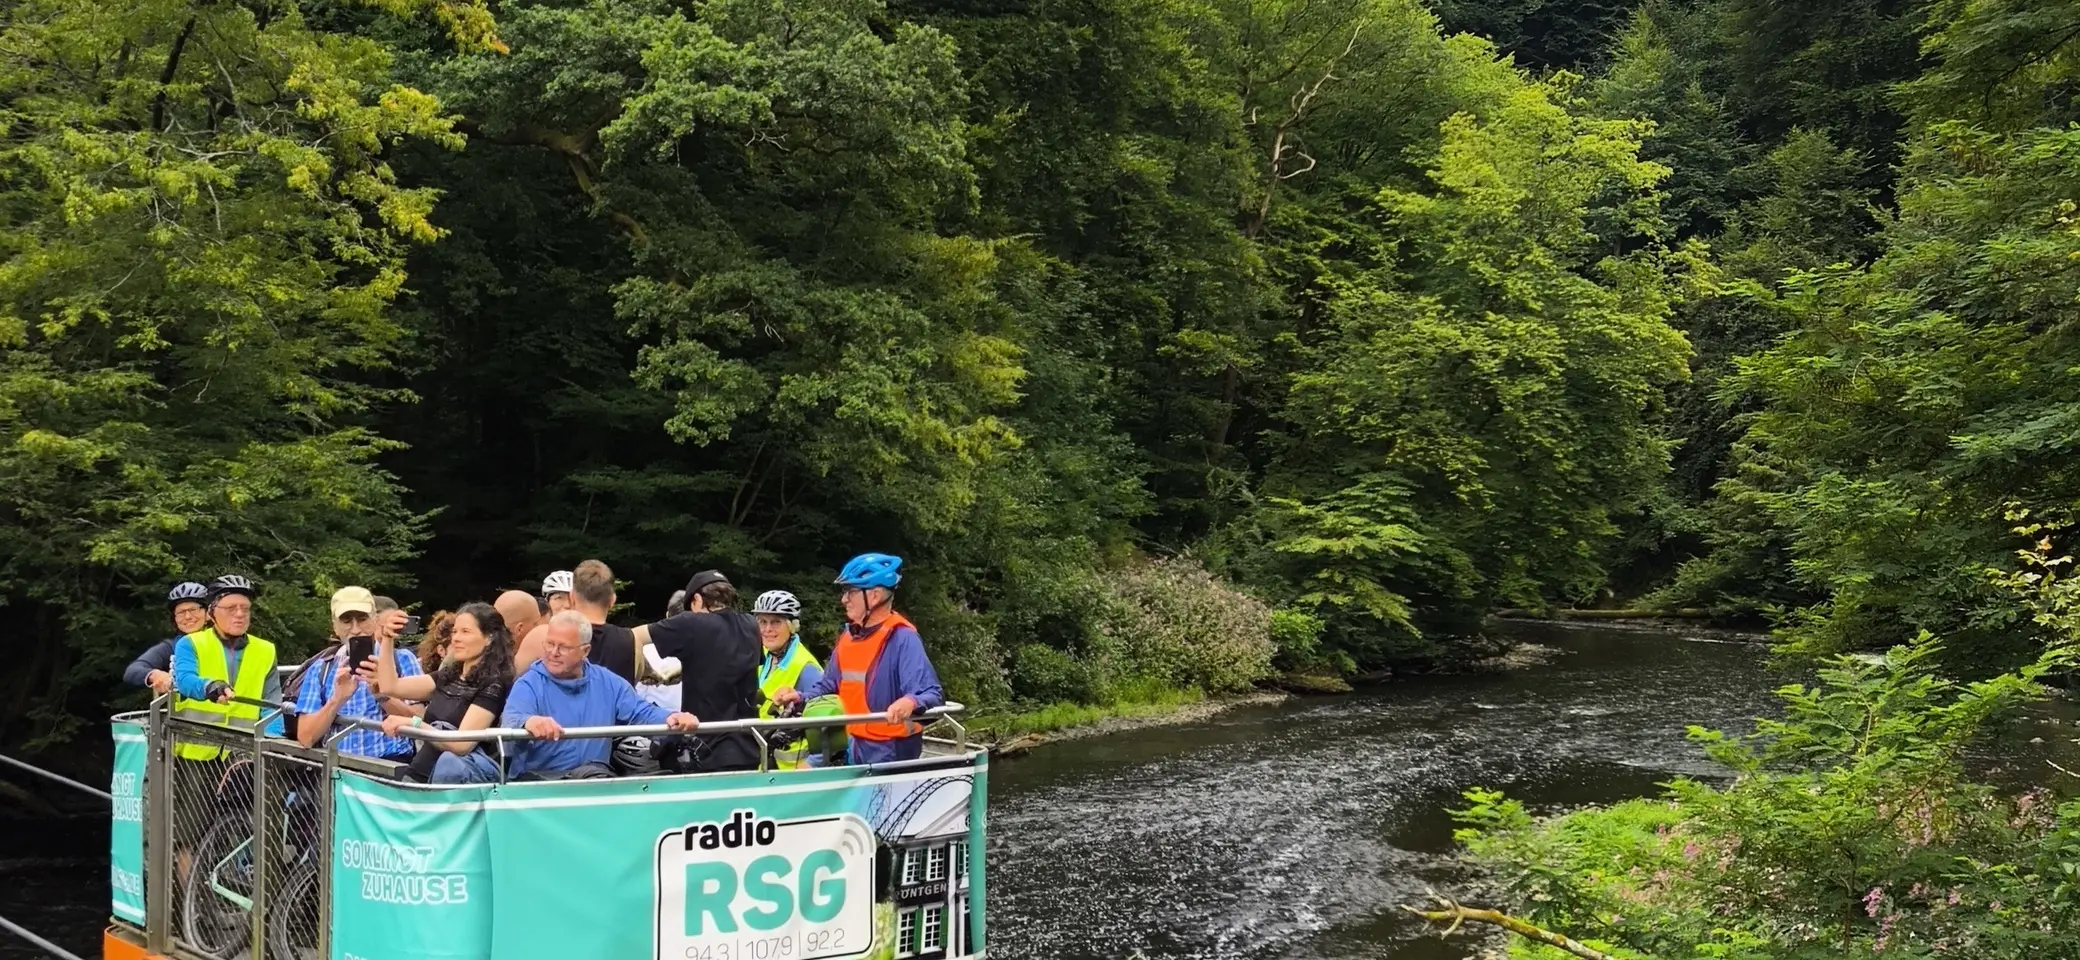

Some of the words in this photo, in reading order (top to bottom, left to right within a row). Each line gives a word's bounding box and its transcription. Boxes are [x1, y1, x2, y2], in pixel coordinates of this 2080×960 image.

[685, 812, 776, 851] radio
[342, 838, 362, 868] SO
[362, 871, 469, 905] ZUHAUSE
[684, 849, 847, 937] RSG
[745, 935, 793, 960] 107,9
[807, 928, 845, 952] 92,2
